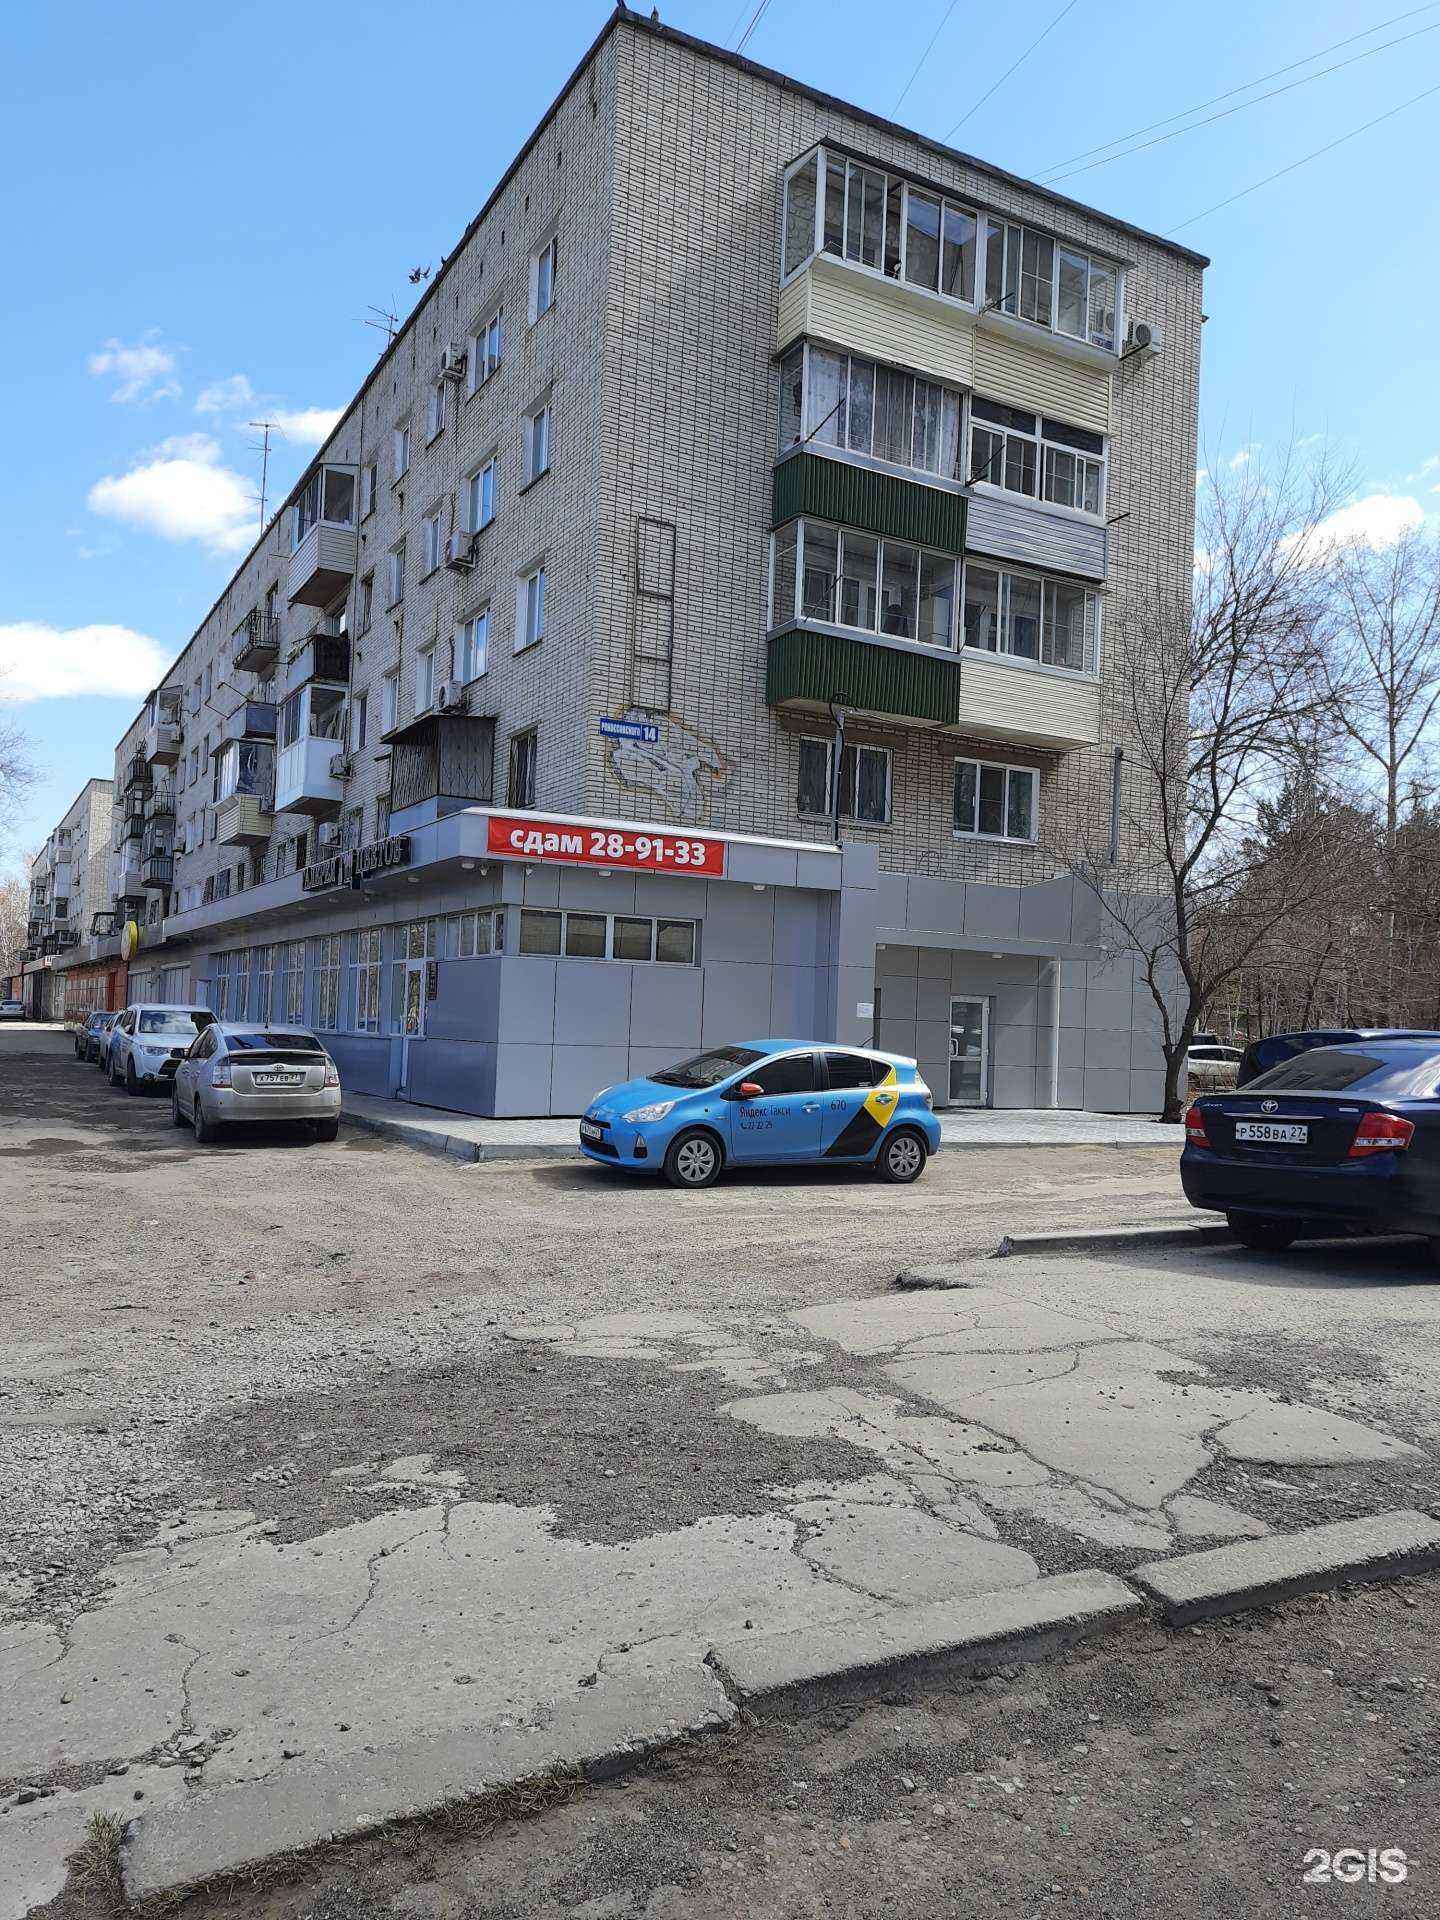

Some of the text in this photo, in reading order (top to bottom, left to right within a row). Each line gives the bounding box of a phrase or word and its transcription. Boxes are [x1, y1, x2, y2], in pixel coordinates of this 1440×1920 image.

[643, 726, 656, 741] 14
[510, 829, 706, 866] сдам 28-91-33
[739, 1105, 791, 1118] Яндекс Такси
[831, 1099, 847, 1111] 670
[1240, 1125, 1287, 1140] Р558ВА
